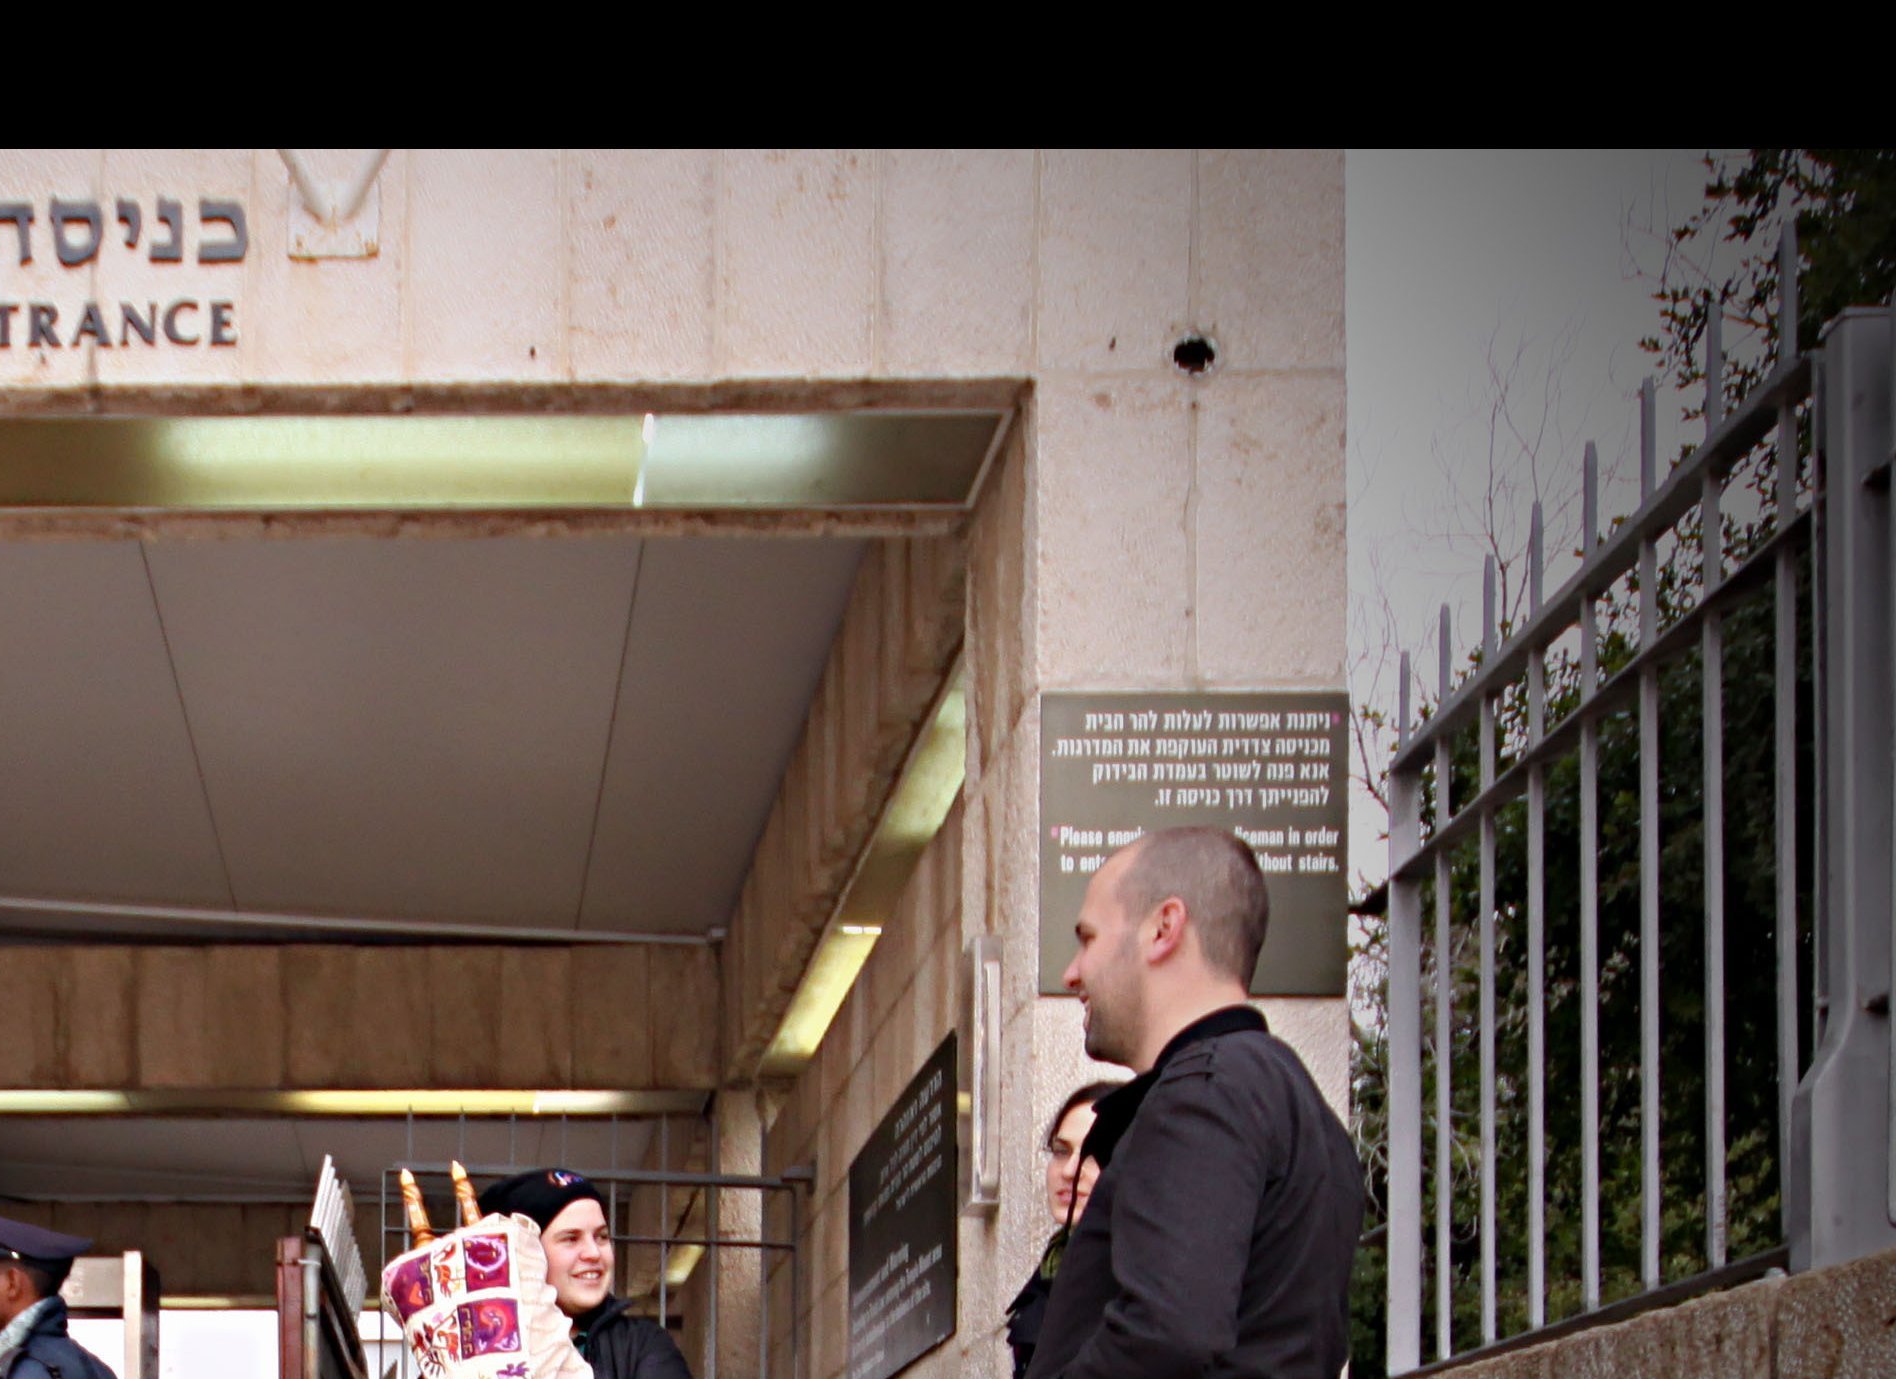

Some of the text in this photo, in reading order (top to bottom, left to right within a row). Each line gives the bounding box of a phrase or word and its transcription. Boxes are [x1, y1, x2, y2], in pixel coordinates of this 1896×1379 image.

[1085, 712, 1124, 731] הבית
[1129, 709, 1158, 731] להר
[1164, 709, 1211, 731] לעלות
[1218, 712, 1280, 731] אפשרות
[1127, 738, 1150, 756] את
[1156, 738, 1217, 760] העוקפת
[1222, 738, 1271, 756] צדדית
[1275, 738, 1330, 756] מכניסה
[1092, 759, 1330, 785] אנא פנה לשוטר בעמדת הבידוק
[1154, 788, 1172, 806] זו.
[1176, 788, 1221, 806] כניסה
[1225, 788, 1253, 810] דרך
[1060, 826, 1103, 847] Please
[1288, 826, 1301, 846] in
[1304, 826, 1339, 846] order
[1060, 853, 1075, 873] to
[1256, 852, 1293, 872] thout
[1298, 852, 1340, 872] stairs.
